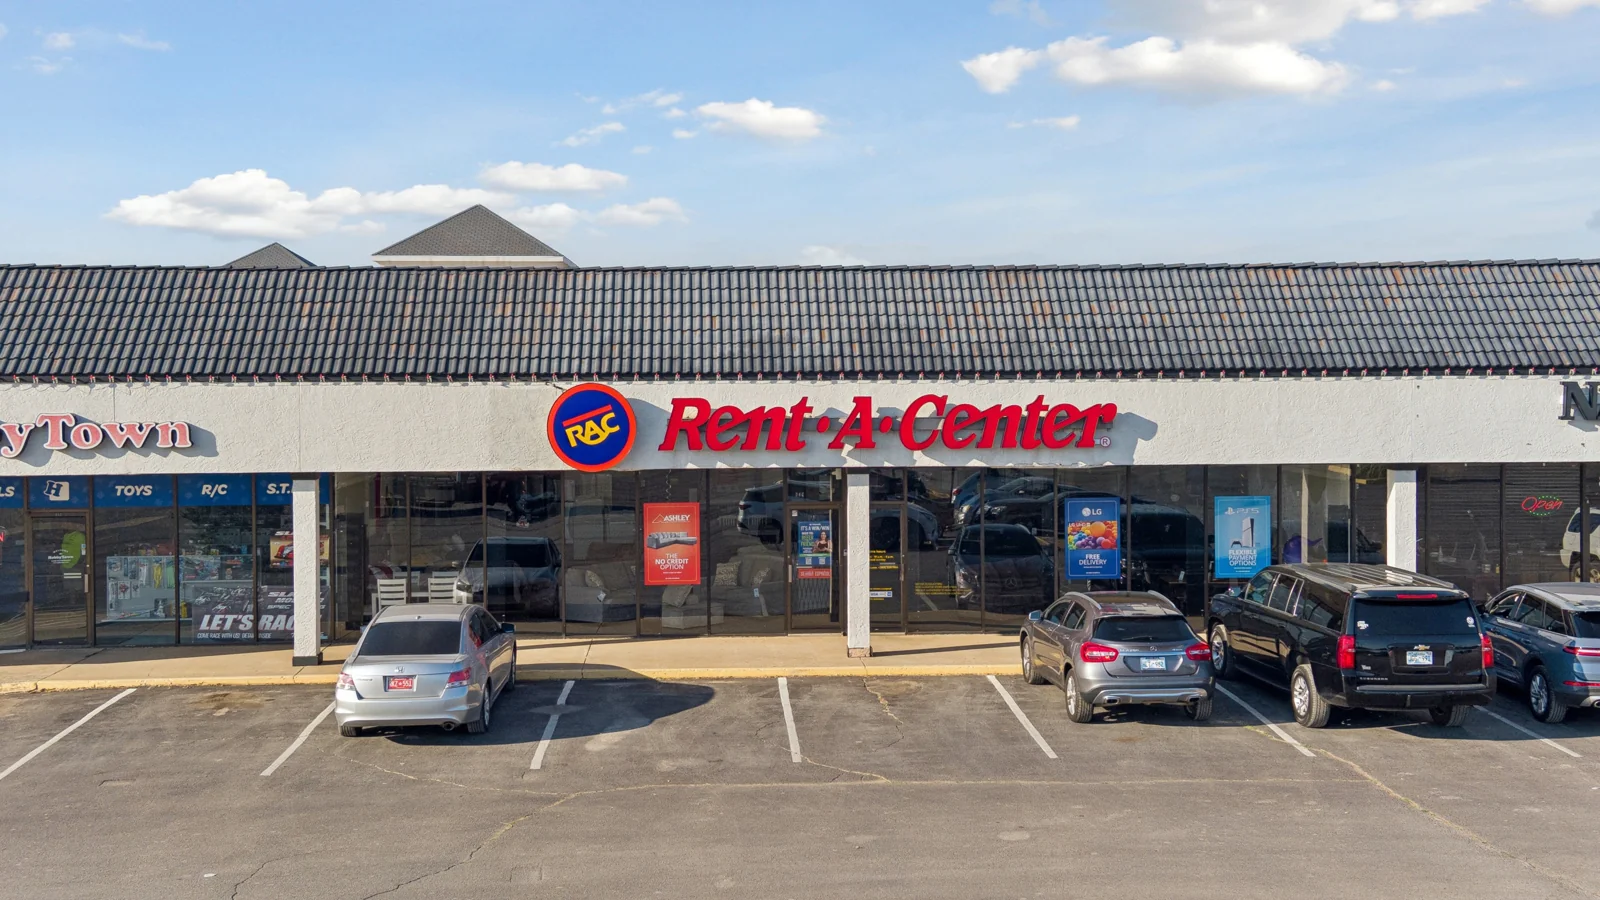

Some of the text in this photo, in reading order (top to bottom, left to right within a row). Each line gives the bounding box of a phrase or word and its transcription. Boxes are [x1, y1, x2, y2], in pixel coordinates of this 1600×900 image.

[1558, 381, 1600, 421] N
[565, 412, 620, 447] RAC
[115, 485, 152, 496] TOYS
[201, 484, 228, 498] R/C
[266, 483, 293, 494] S.T.
[1521, 496, 1563, 511] Open
[663, 514, 690, 522] ASHLEY
[1092, 508, 1102, 516] LG
[199, 614, 254, 631] LET'S
